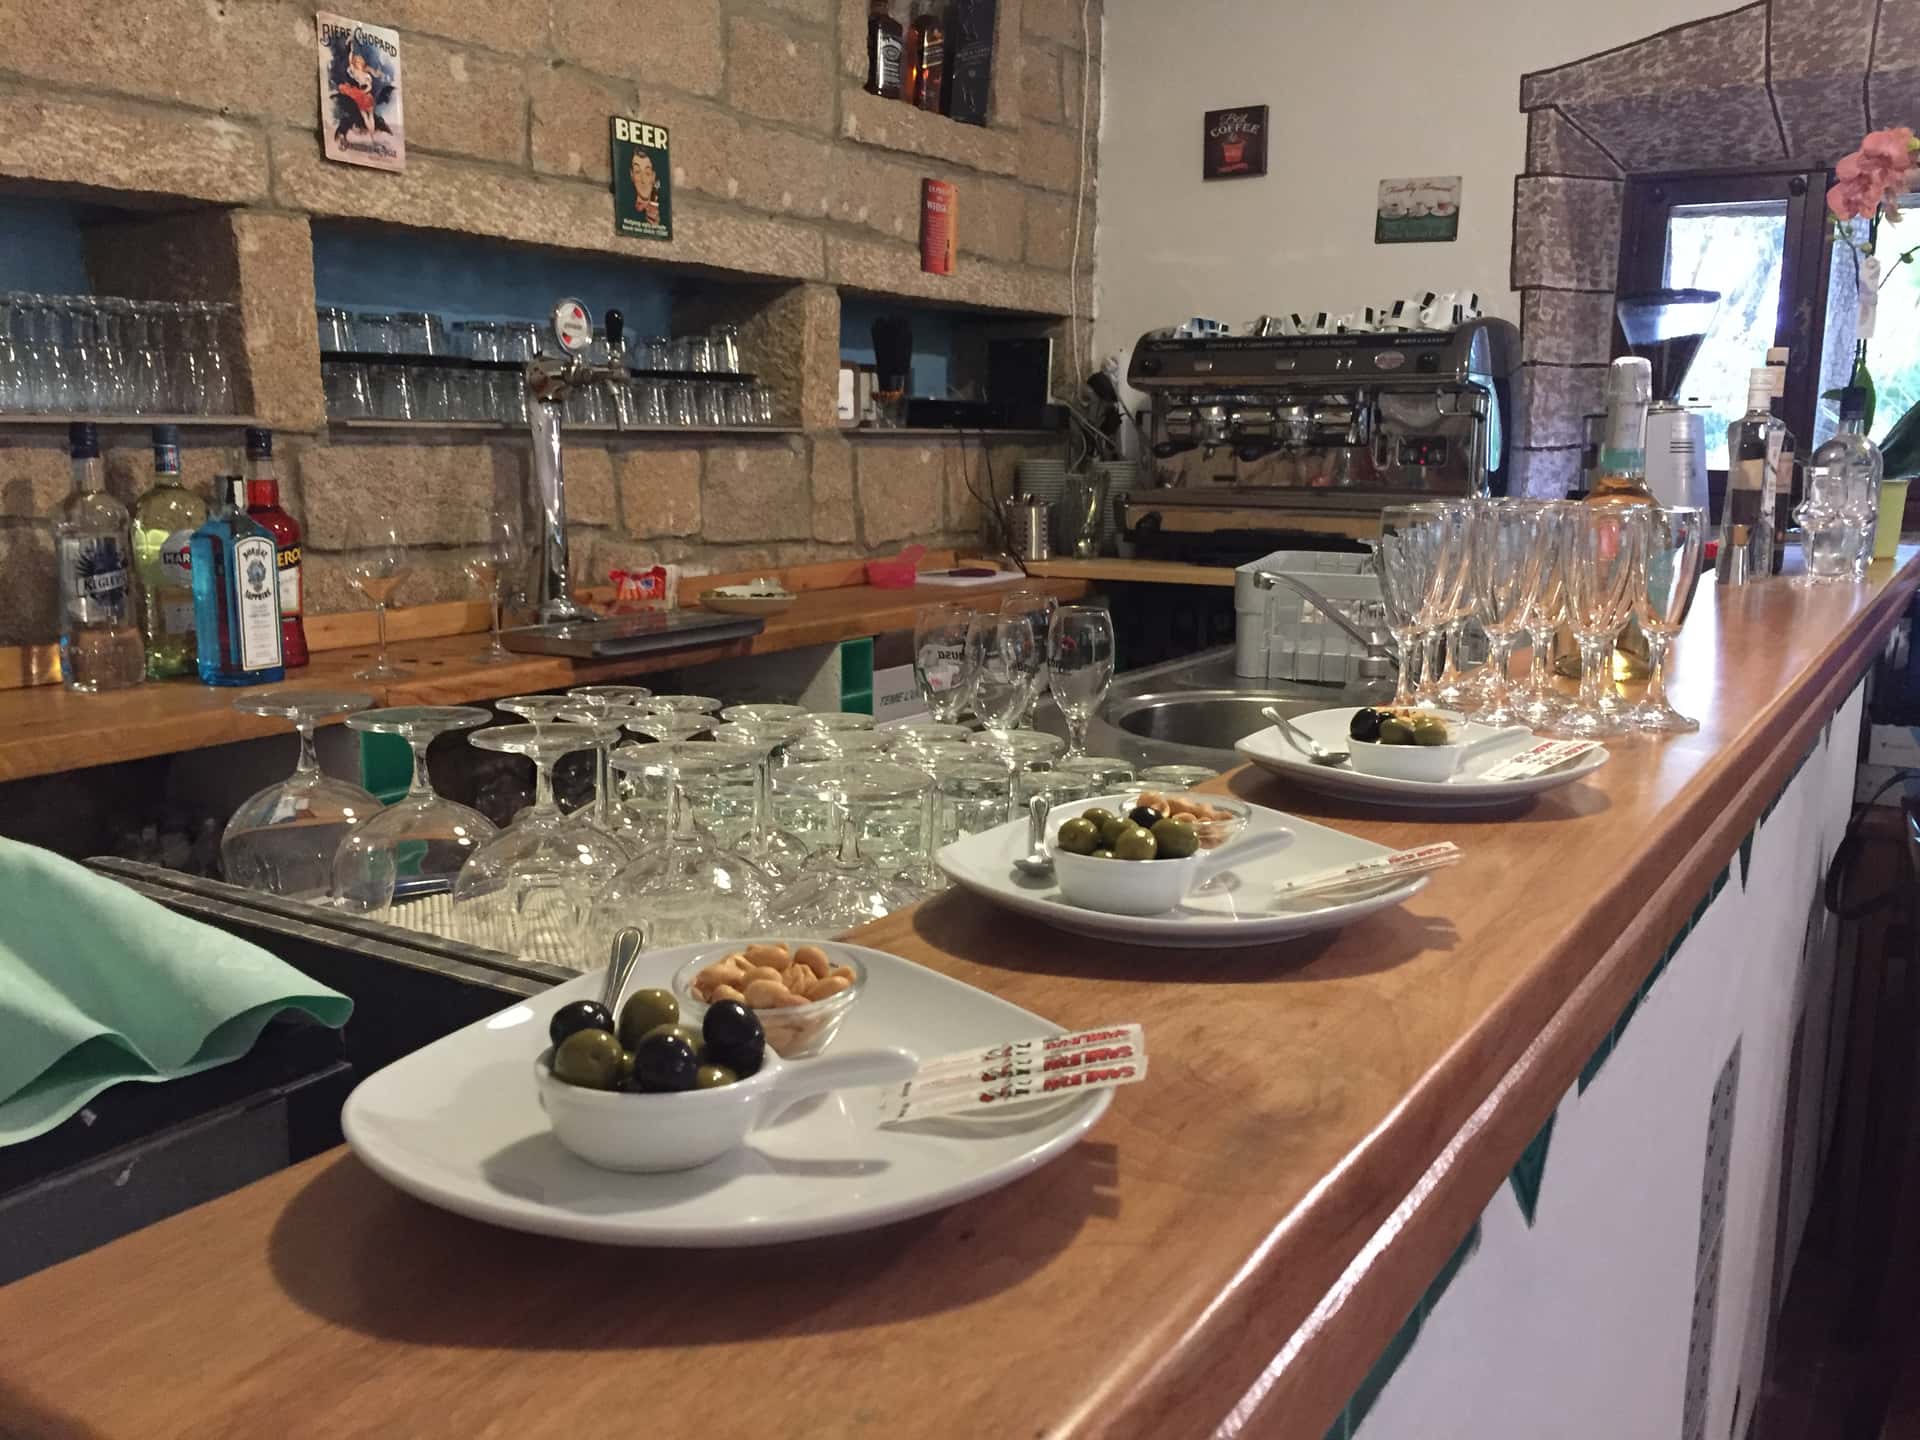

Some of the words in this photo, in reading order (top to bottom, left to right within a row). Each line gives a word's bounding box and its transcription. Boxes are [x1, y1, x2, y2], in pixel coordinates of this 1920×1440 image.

[354, 25, 398, 58] CHOPARD
[615, 117, 668, 150] BEER
[1210, 122, 1260, 137] COFFEE
